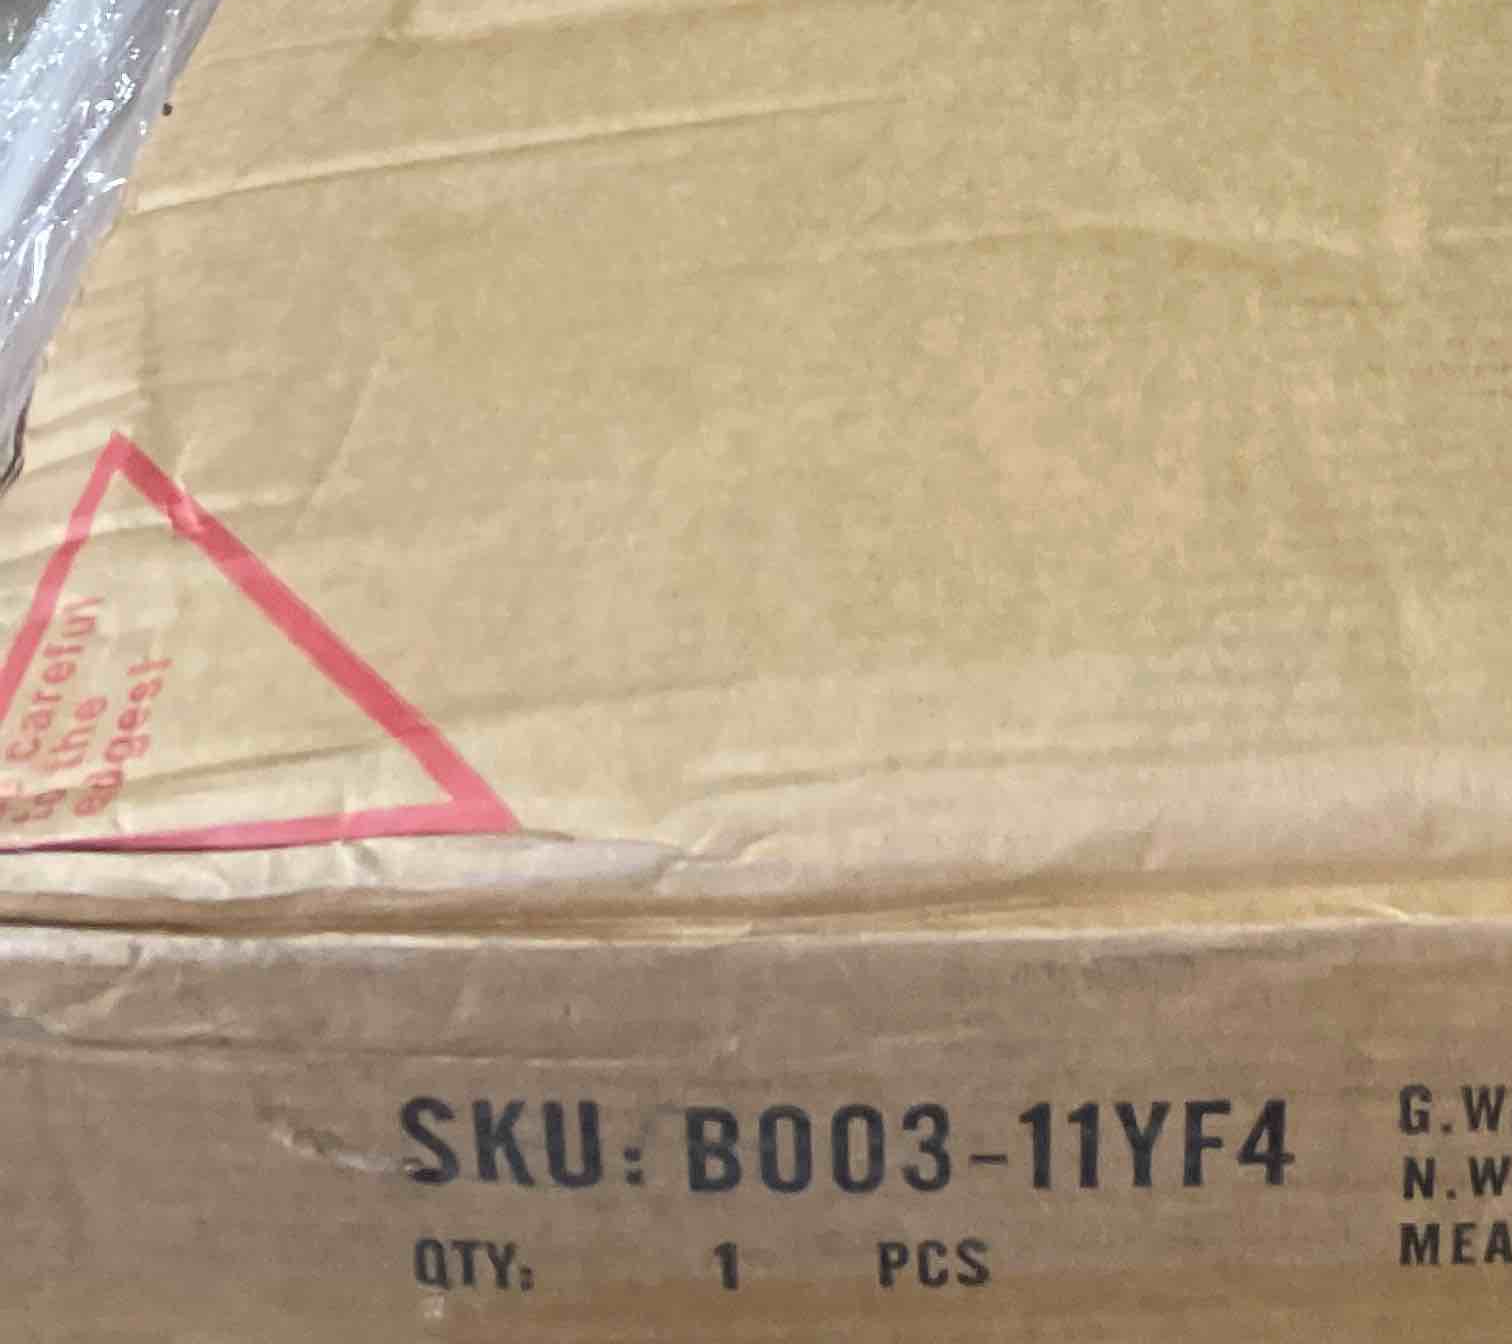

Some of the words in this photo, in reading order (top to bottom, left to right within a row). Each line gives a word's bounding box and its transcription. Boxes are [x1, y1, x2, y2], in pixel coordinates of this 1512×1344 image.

[399, 1095, 645, 1186] SKU:
[683, 1098, 1296, 1194] B003-11YF4
[414, 1239, 536, 1292] QTY:
[714, 1241, 741, 1290] 1
[877, 1238, 992, 1289] PCS
